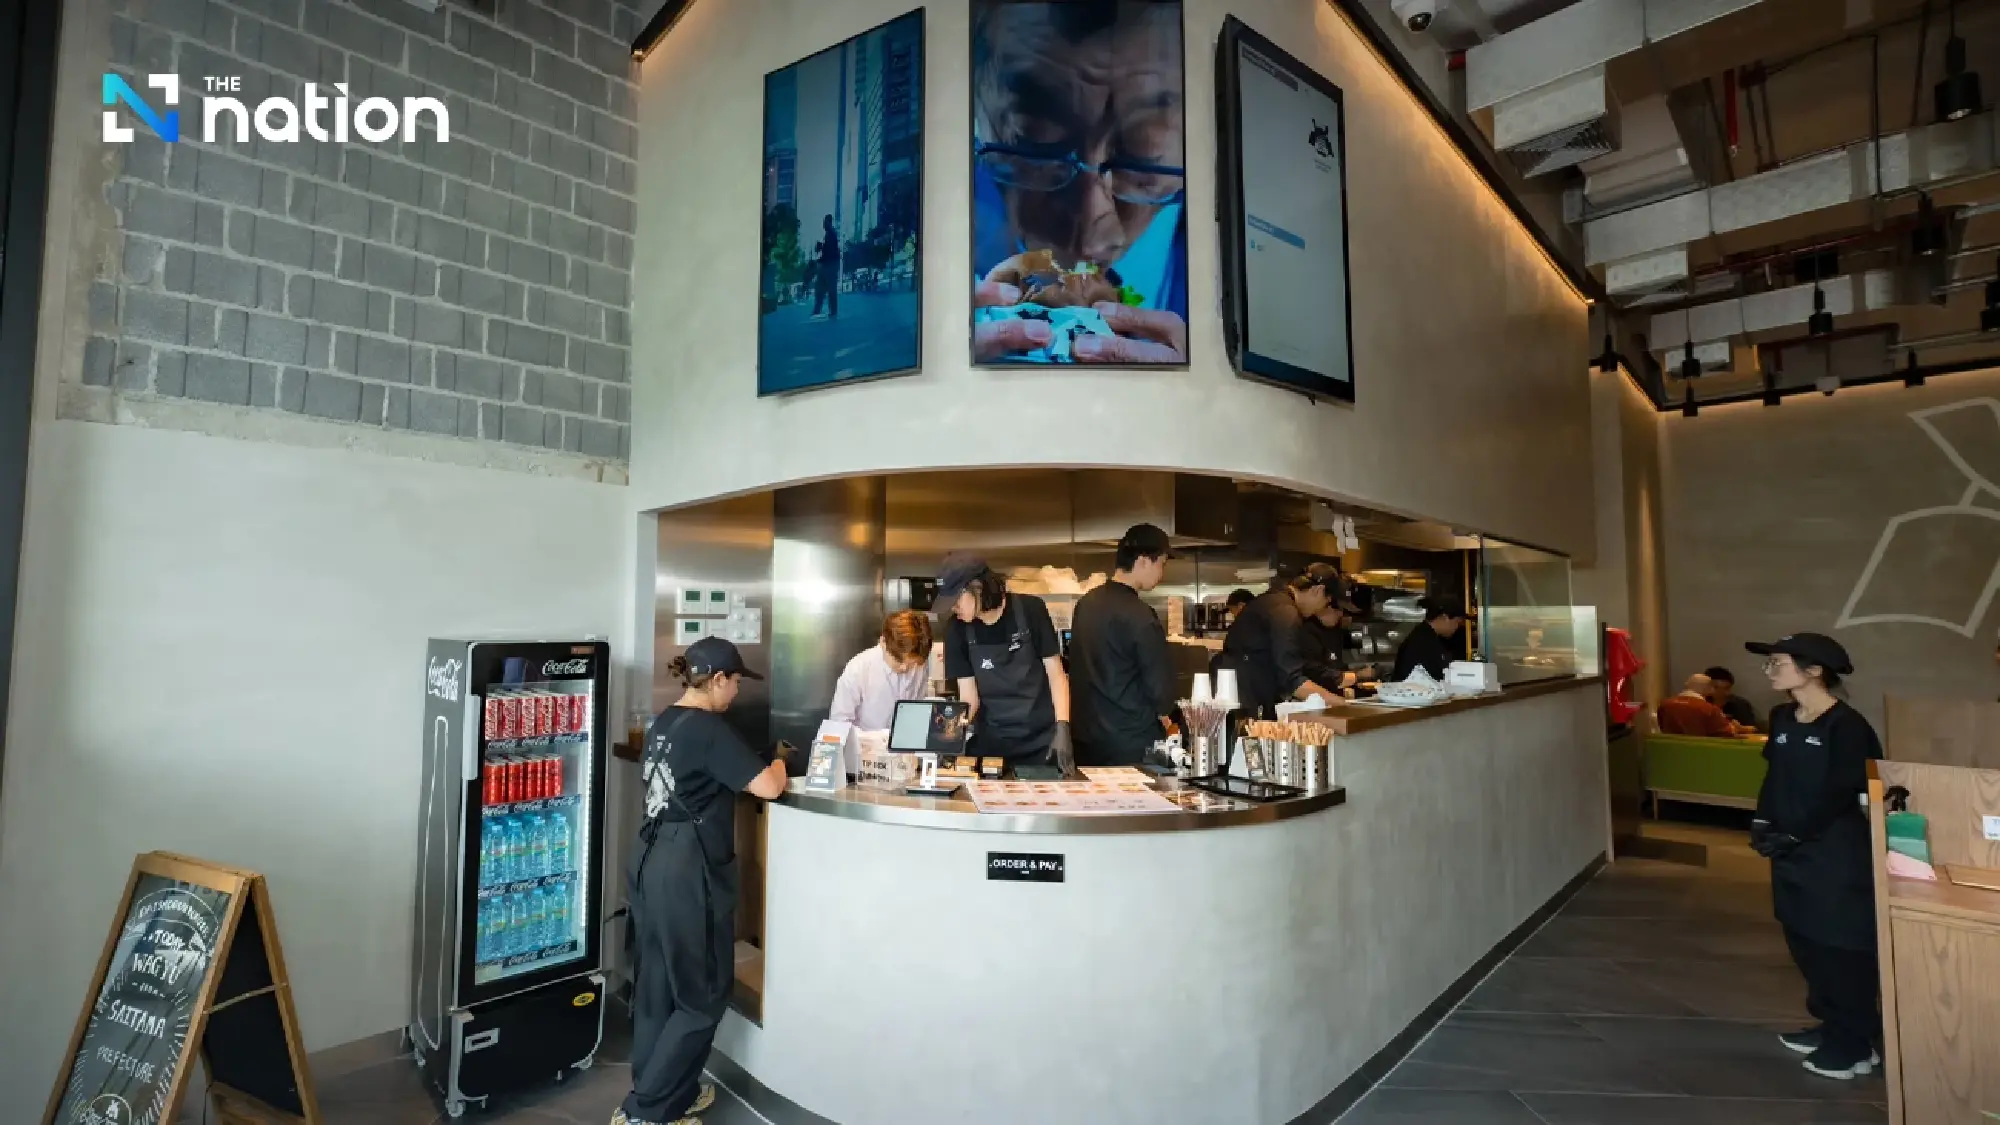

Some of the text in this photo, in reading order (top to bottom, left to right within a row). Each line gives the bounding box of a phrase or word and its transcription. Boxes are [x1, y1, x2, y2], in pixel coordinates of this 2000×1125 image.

[993, 858, 1058, 871] ORDER & PAY
[107, 999, 167, 1040] SAITAMA
[96, 1044, 156, 1084] PREFECTURE
